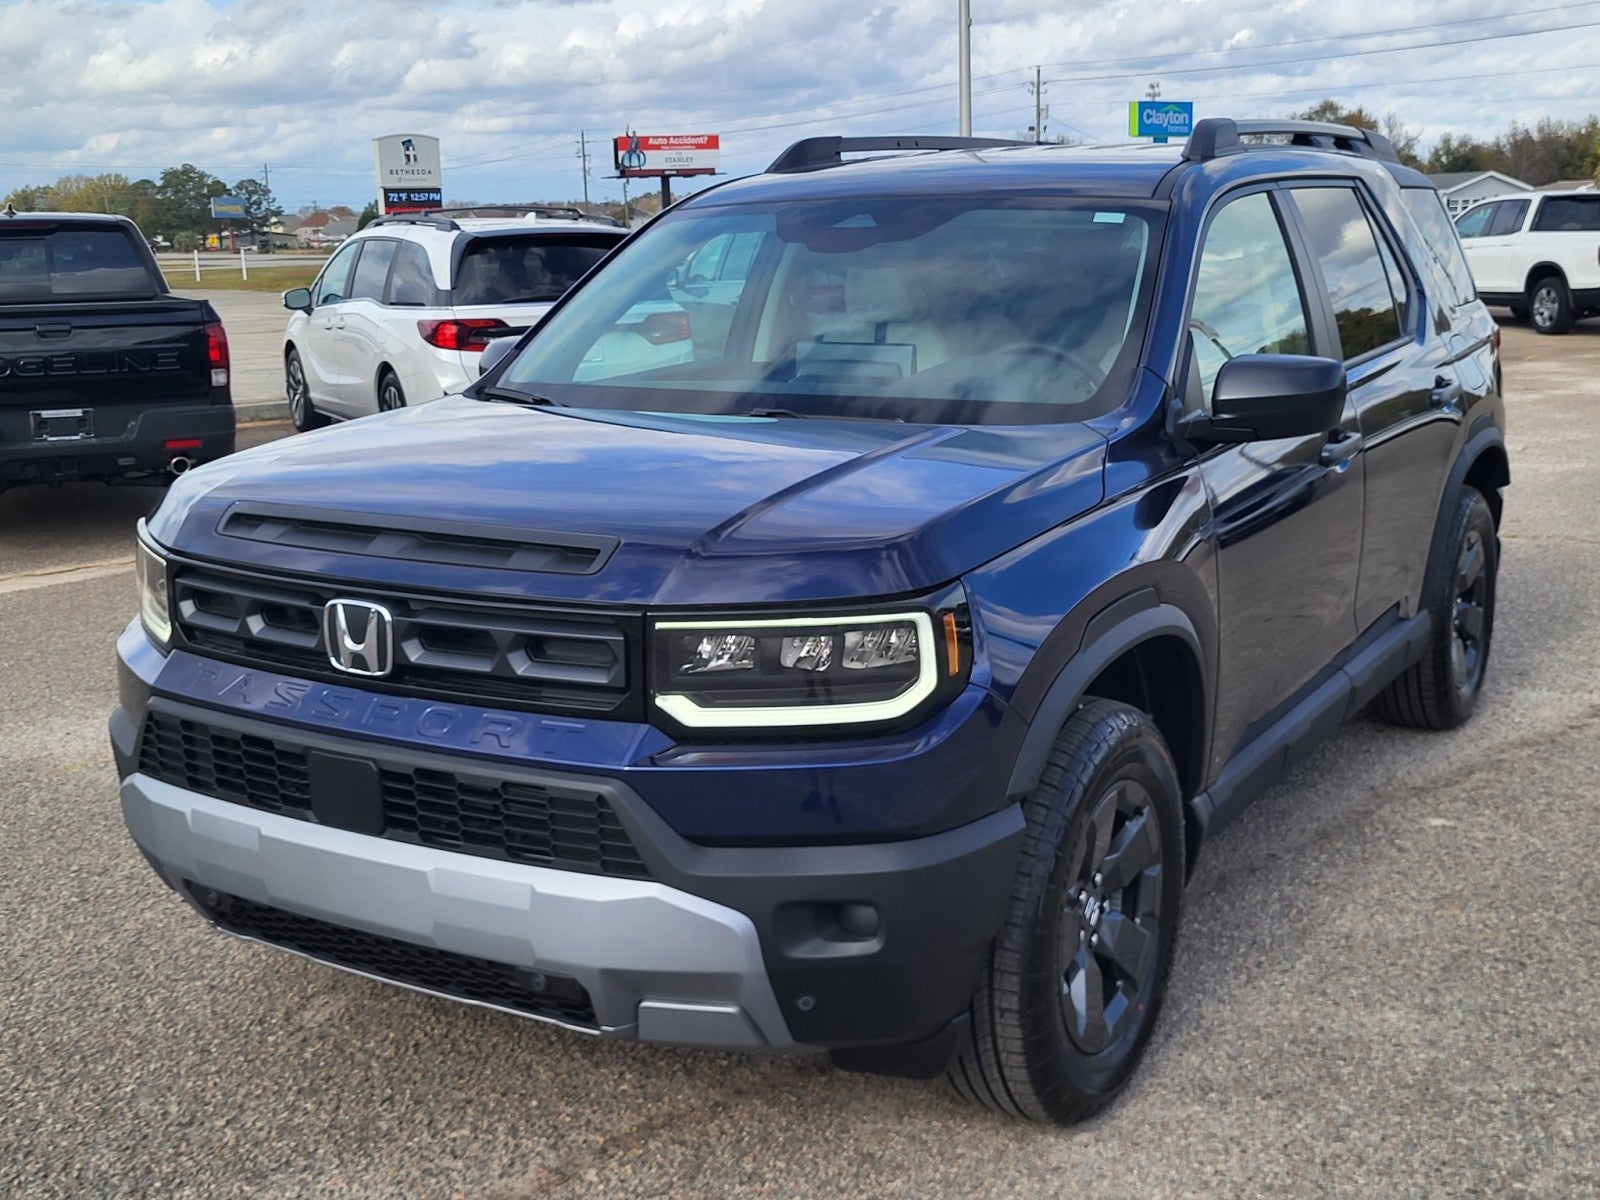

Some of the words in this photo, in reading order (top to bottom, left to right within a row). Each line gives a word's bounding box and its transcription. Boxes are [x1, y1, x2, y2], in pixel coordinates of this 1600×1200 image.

[1142, 108, 1189, 127] Clayton
[669, 136, 708, 145] Accident?
[429, 192, 441, 201] PM
[194, 661, 586, 755] PASSPORT
